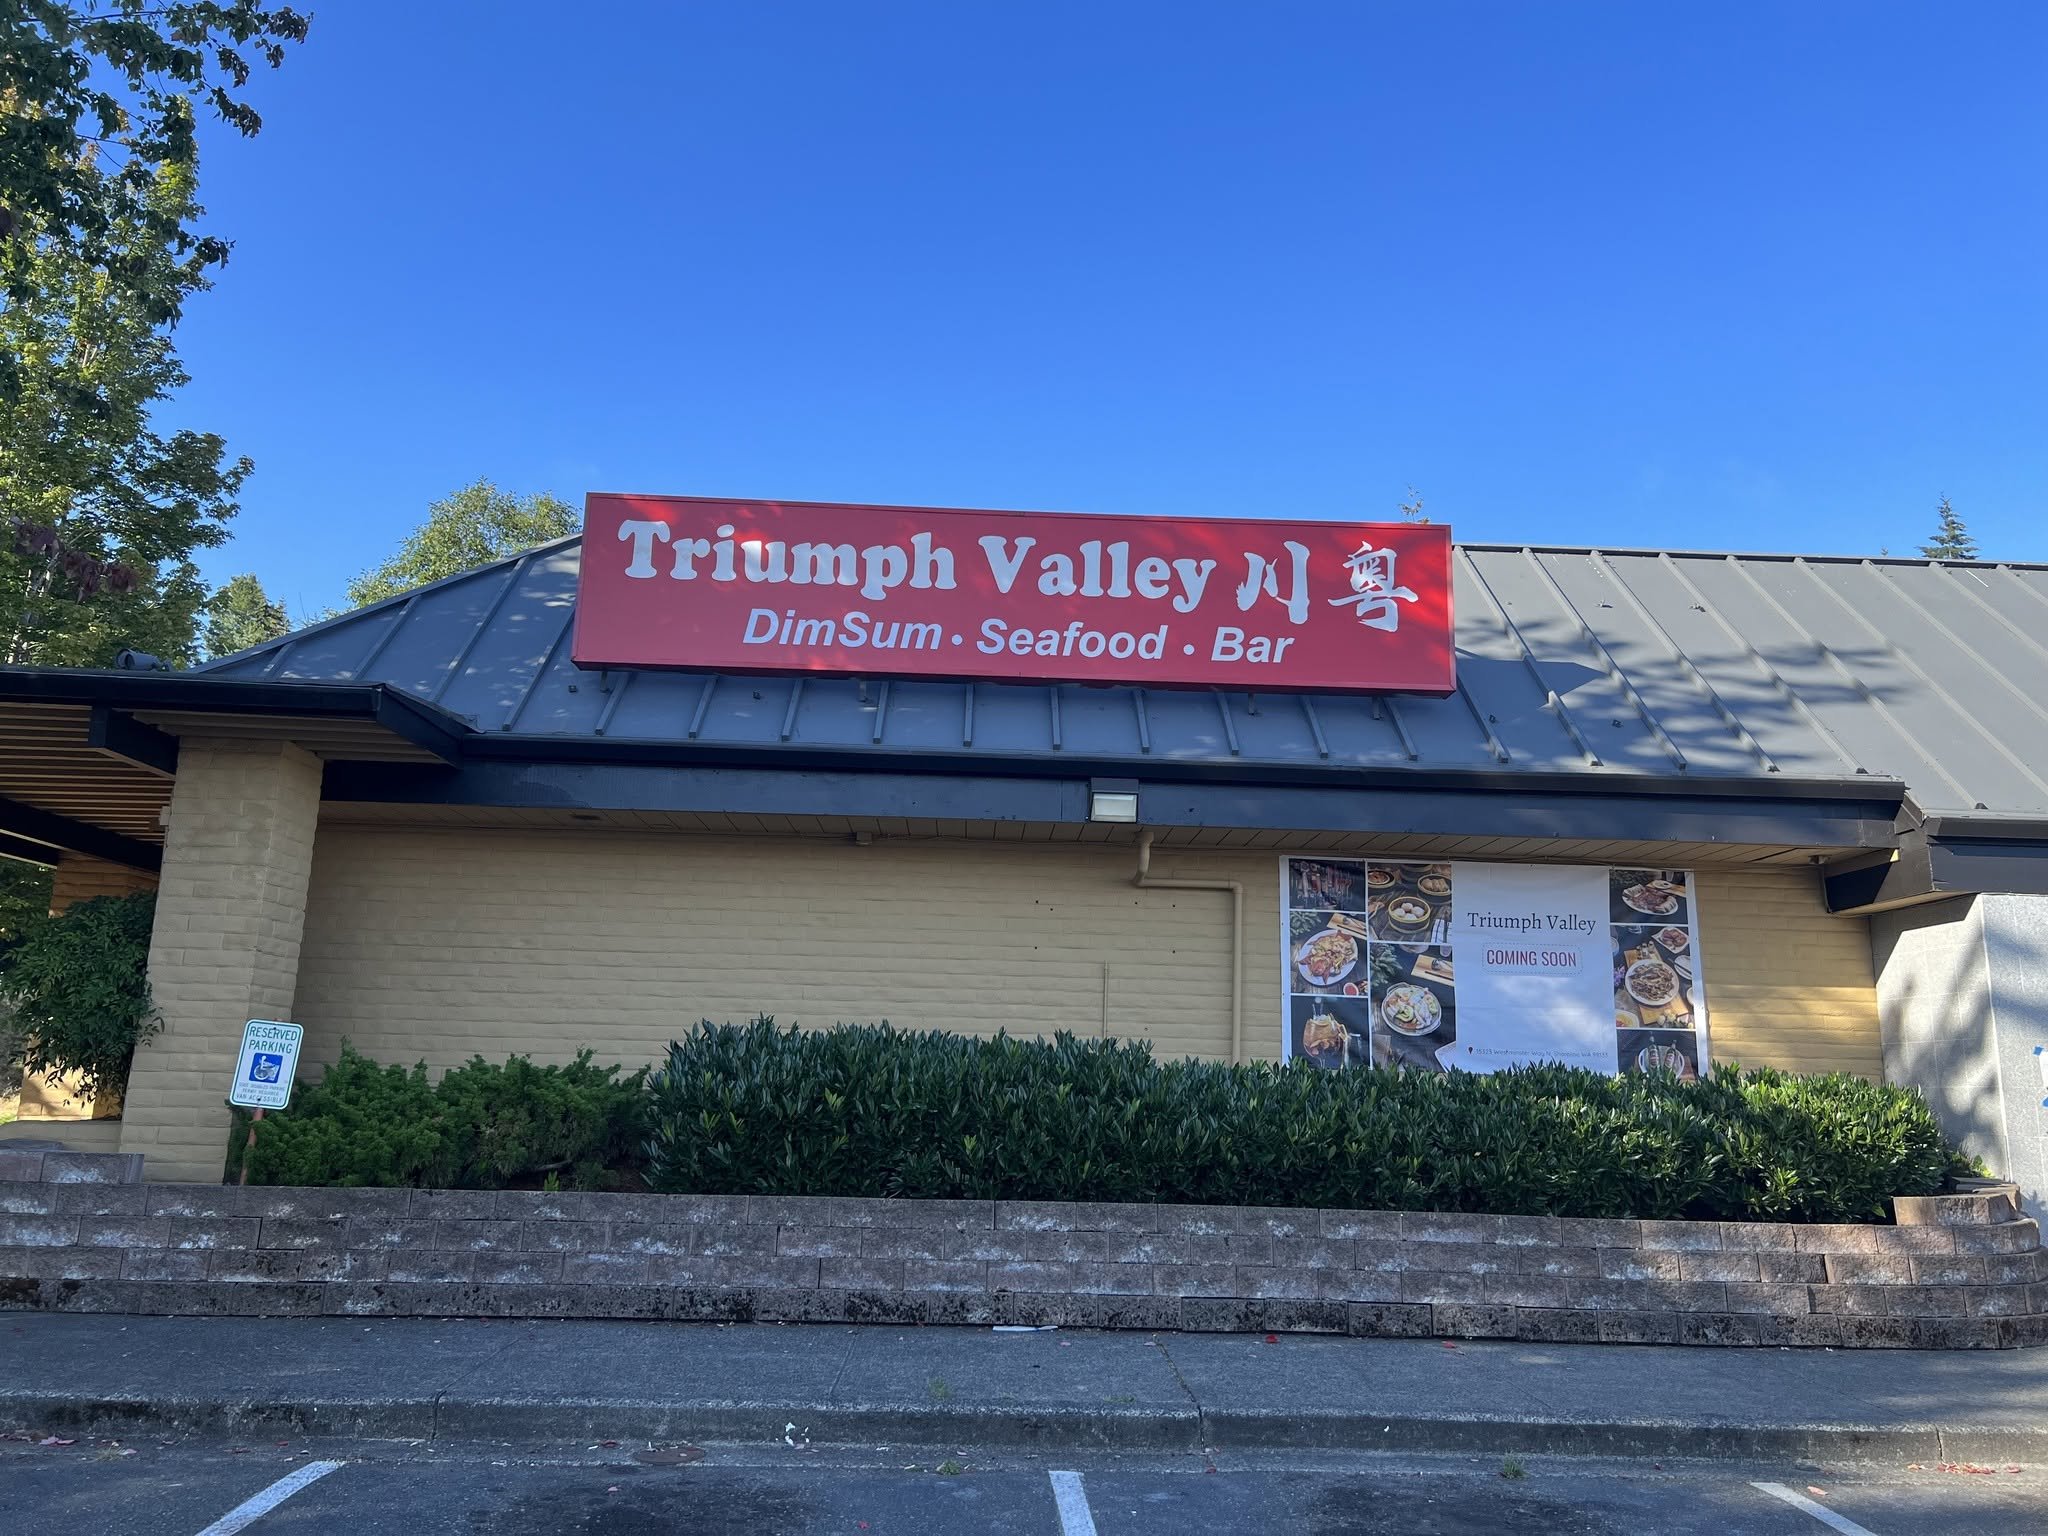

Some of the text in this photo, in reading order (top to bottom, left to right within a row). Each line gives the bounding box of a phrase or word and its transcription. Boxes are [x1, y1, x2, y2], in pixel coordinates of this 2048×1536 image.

[617, 519, 1217, 613] Triumph Valley
[743, 607, 1295, 664] DimSum Seafood Bar
[1467, 912, 1596, 936] Triumph Valley
[1486, 949, 1577, 967] COMING SOON
[249, 1026, 297, 1040] RESERVED
[249, 1040, 292, 1053] PARKING
